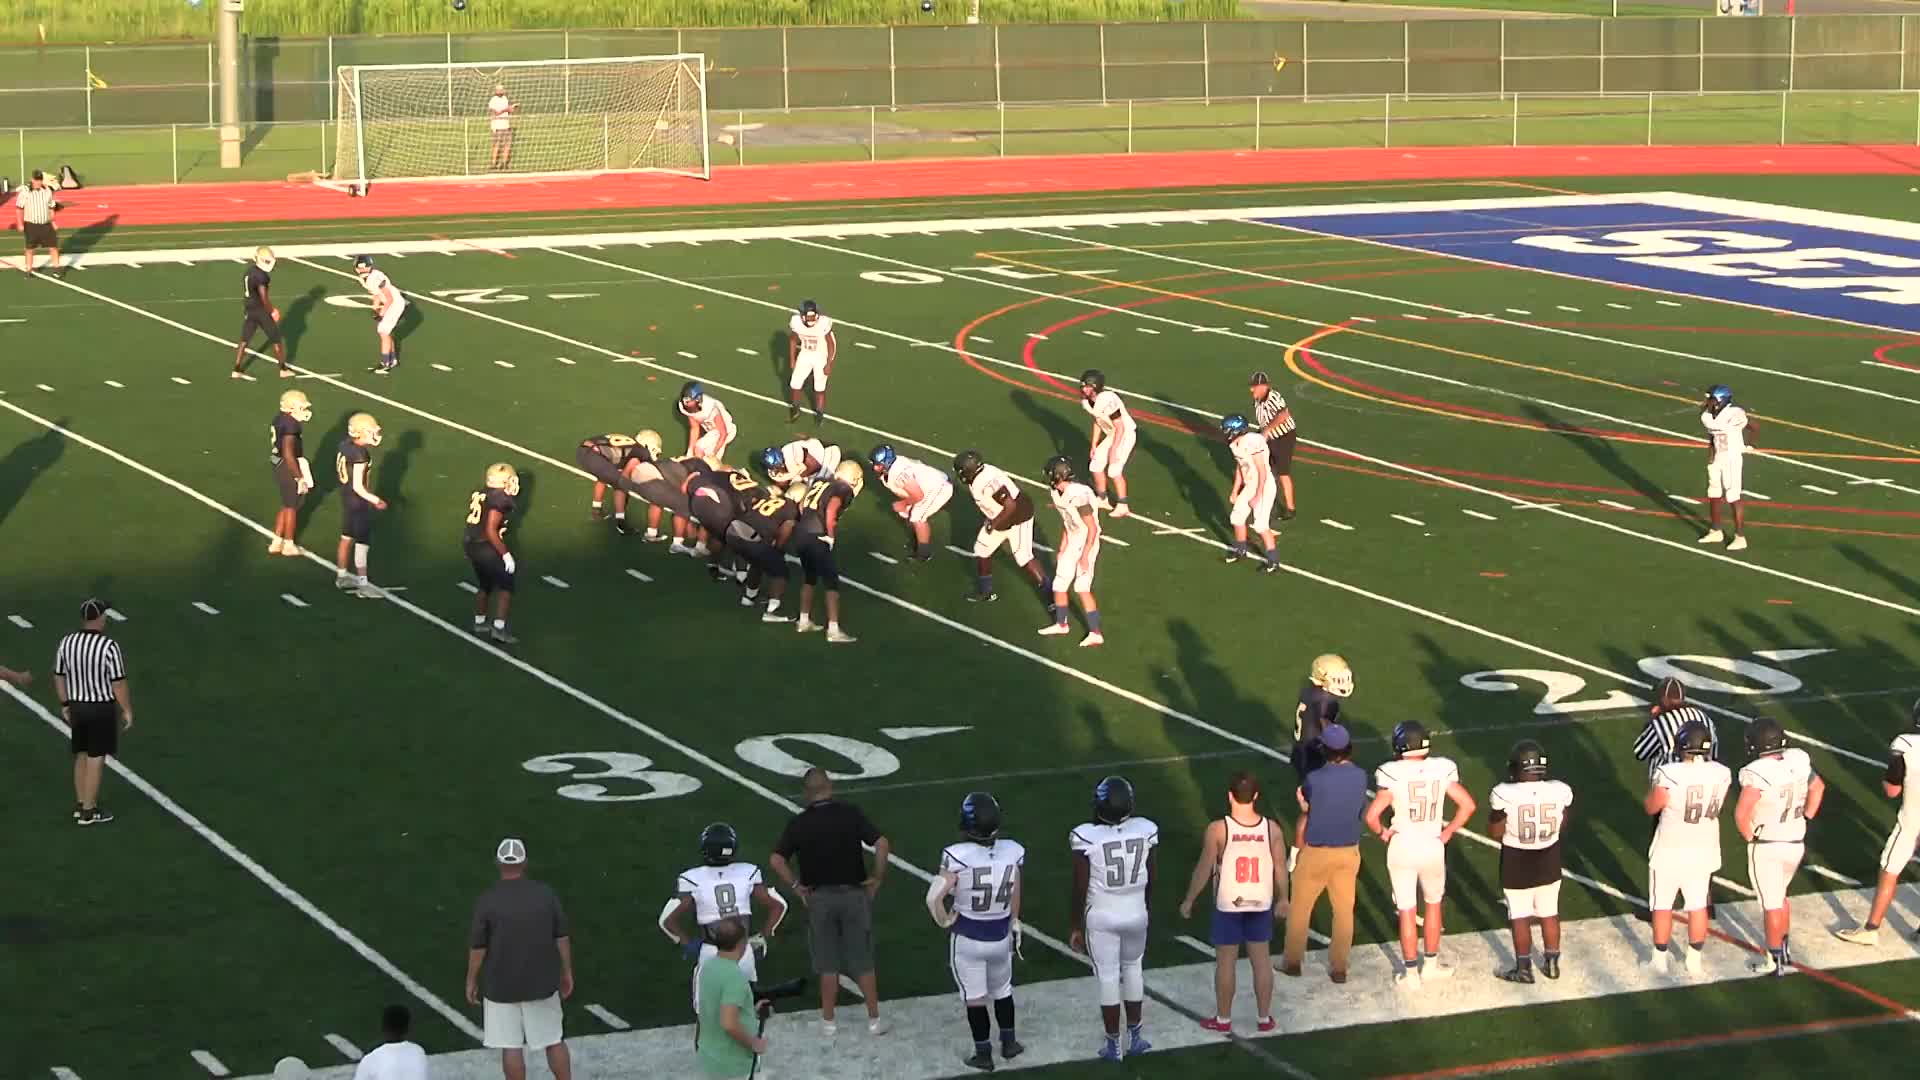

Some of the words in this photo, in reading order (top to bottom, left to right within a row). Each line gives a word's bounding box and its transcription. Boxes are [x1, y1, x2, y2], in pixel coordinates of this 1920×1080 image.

[1460, 654, 1803, 715] 20
[521, 733, 901, 802] 30
[1408, 779, 1441, 823] 51
[1517, 803, 1557, 844] 65
[1683, 784, 1721, 825] 64
[1102, 837, 1145, 888] 57
[1235, 856, 1260, 884] 81
[971, 864, 1014, 912] 54
